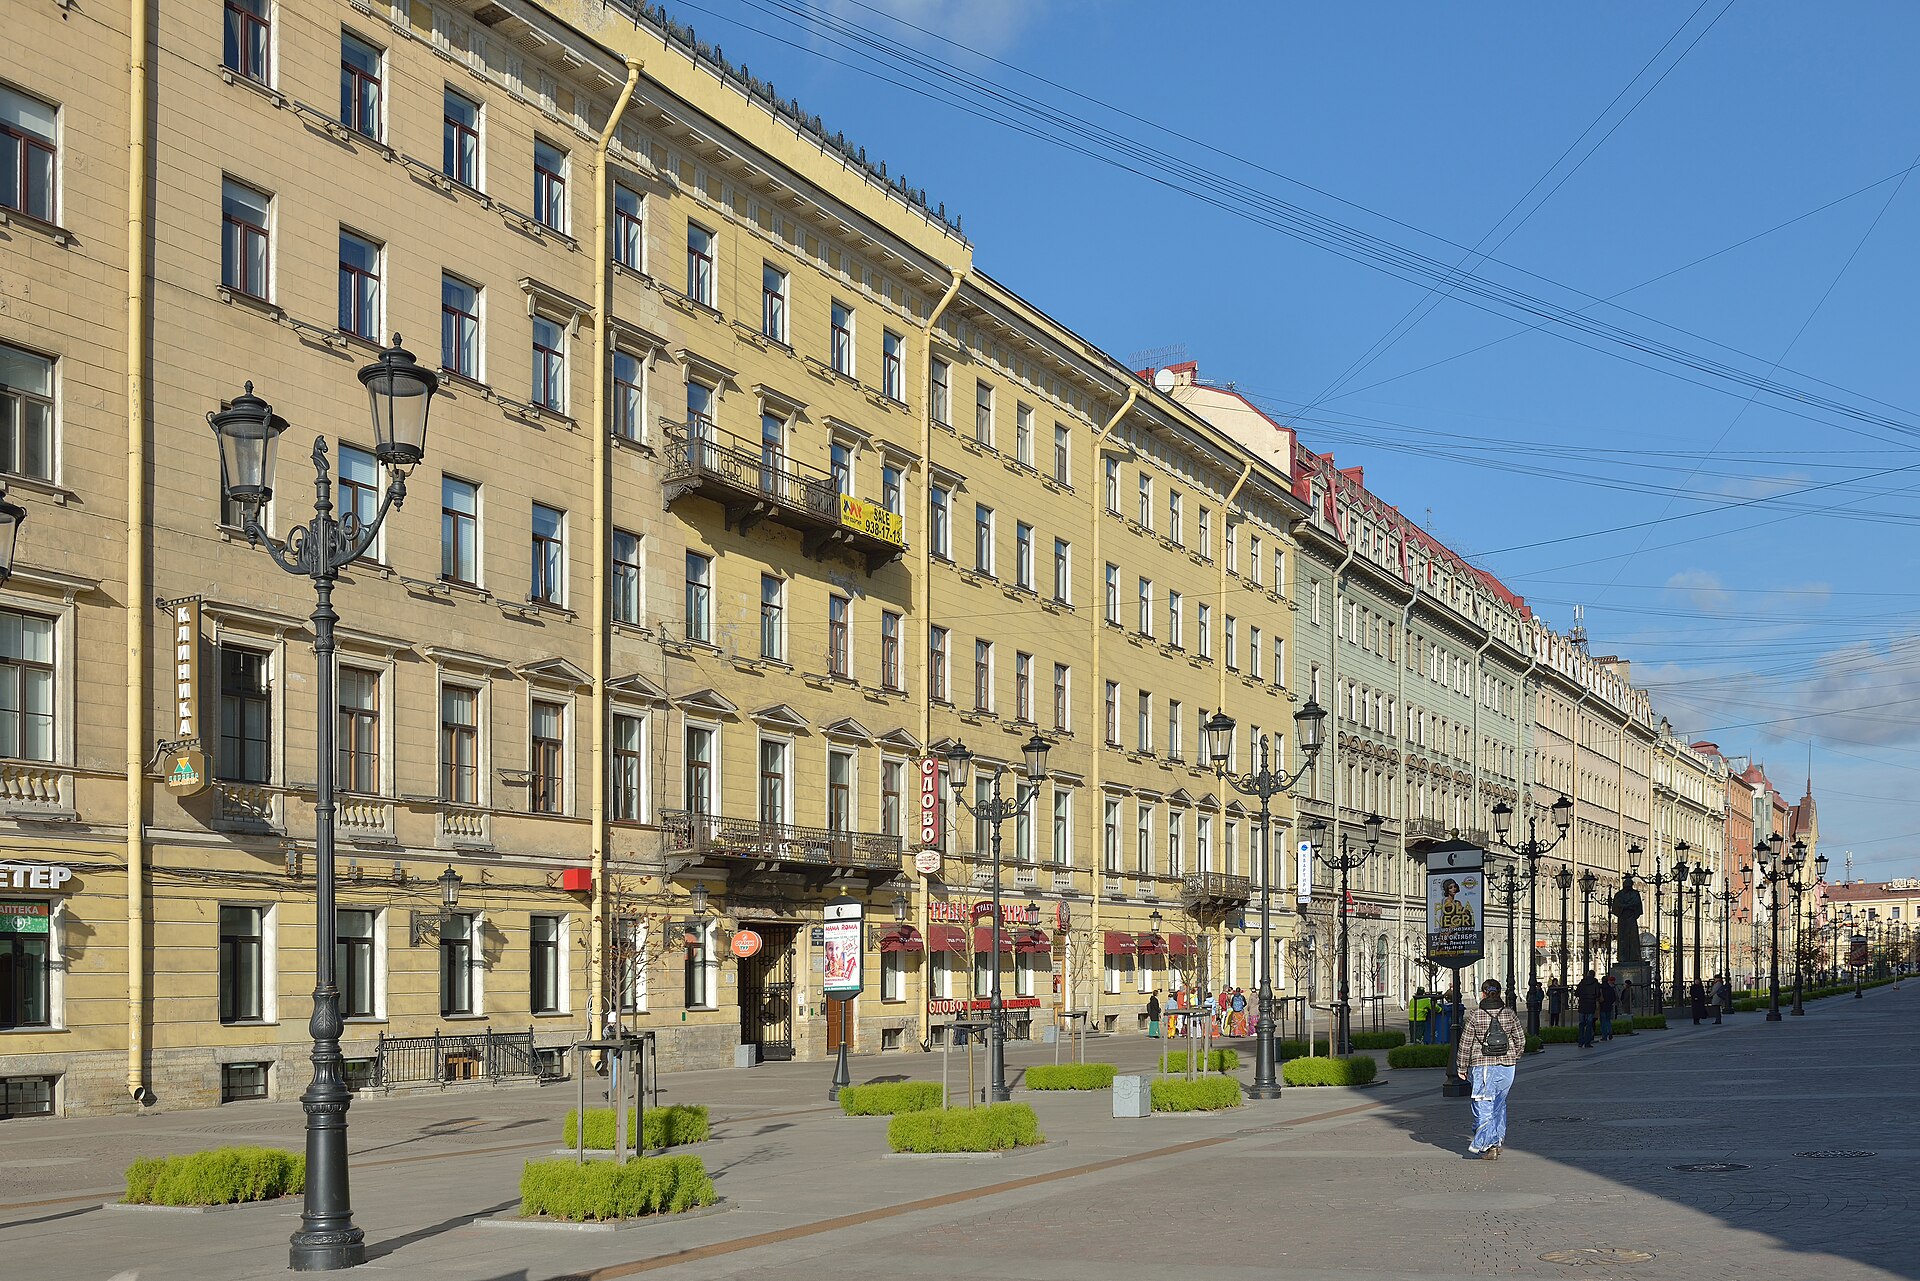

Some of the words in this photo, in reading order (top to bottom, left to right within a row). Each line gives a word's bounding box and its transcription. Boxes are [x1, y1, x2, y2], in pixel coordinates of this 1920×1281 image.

[874, 508, 890, 526] SALE
[865, 519, 901, 543] 938-17-13
[177, 606, 192, 735] КЛИНИКА
[921, 759, 935, 843] СЛОВО
[0, 905, 39, 914] АПТЕКА
[1434, 901, 1473, 915] POLA
[1434, 914, 1475, 927] NEGRI
[927, 1000, 964, 1014] СЛОВО
